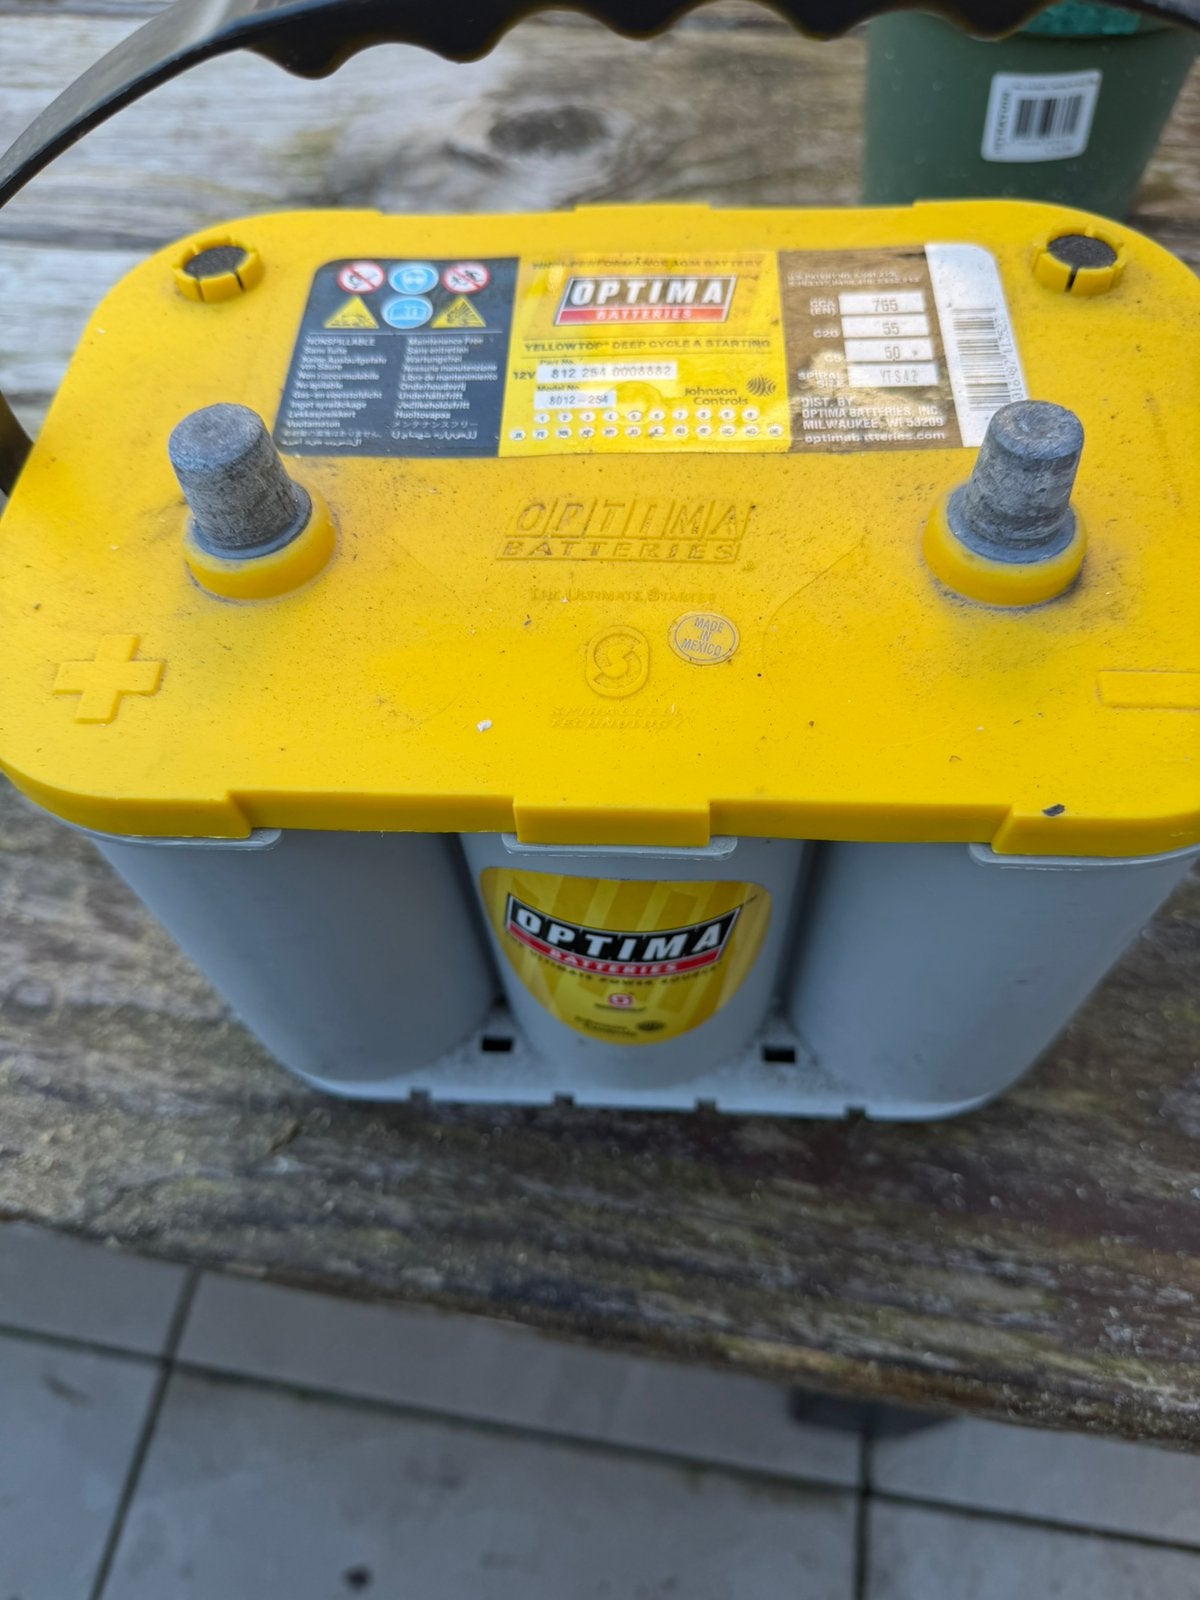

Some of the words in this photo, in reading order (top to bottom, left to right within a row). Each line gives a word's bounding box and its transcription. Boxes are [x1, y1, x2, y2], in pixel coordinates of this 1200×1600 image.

[569, 279, 723, 305] OPTIMA
[872, 299, 899, 312] 765
[596, 309, 693, 321] BATTERIES
[882, 322, 900, 336] 55
[612, 340, 645, 349] DEEP
[649, 339, 690, 348] CYCLE
[705, 339, 770, 348] STARTING
[885, 346, 901, 359] 50
[513, 371, 536, 380] 12V
[551, 368, 576, 380] 812
[684, 387, 738, 396] Johnson
[693, 396, 749, 406] Controls
[837, 396, 854, 407] BY
[802, 407, 846, 419] OPTIMA
[515, 502, 740, 536] OPTIMA
[502, 540, 736, 561] BATTERIES
[693, 616, 726, 634] MADE
[698, 630, 713, 643] IN
[680, 637, 723, 657] MEXICO
[515, 907, 723, 962] OPTIMA
[549, 948, 677, 975] BATTERIES
